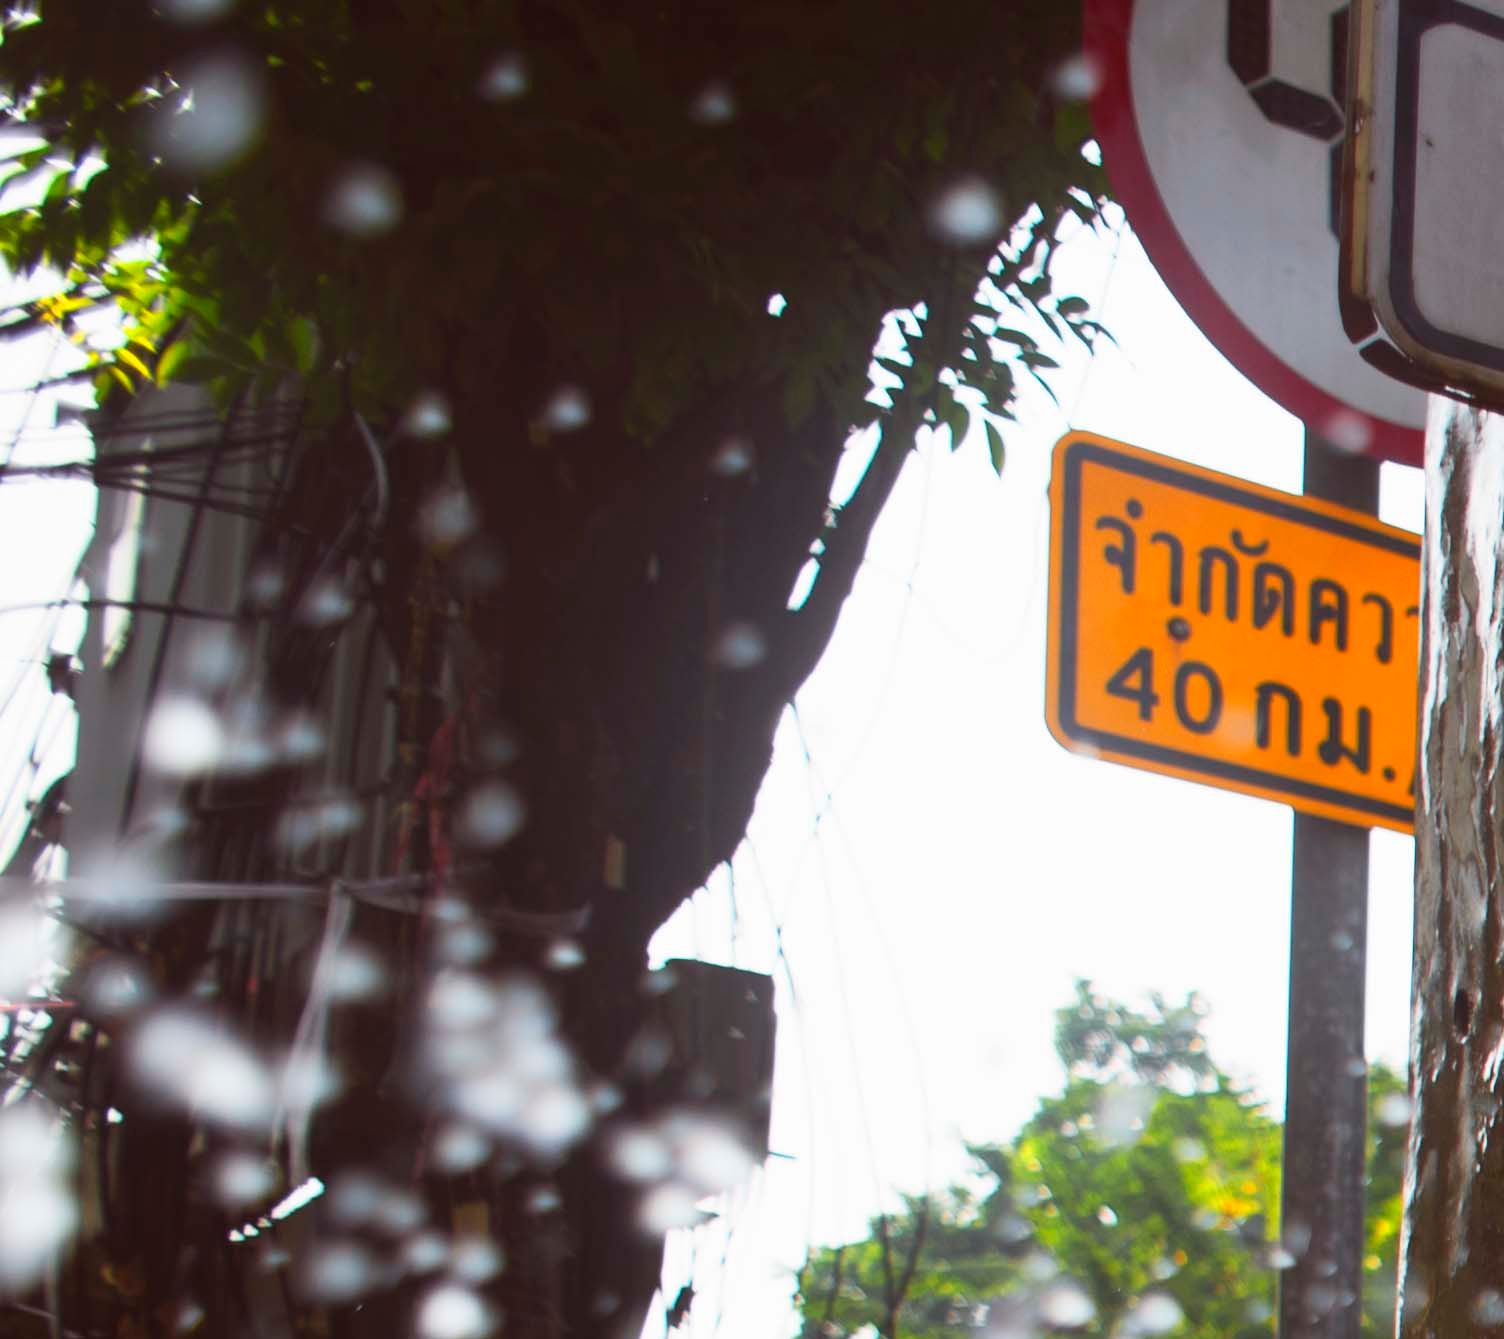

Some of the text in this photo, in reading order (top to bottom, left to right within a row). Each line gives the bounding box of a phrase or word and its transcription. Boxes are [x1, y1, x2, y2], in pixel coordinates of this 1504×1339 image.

[1094, 497, 1419, 665] จำกัดคว
[1104, 647, 1416, 796] 40 กม.
